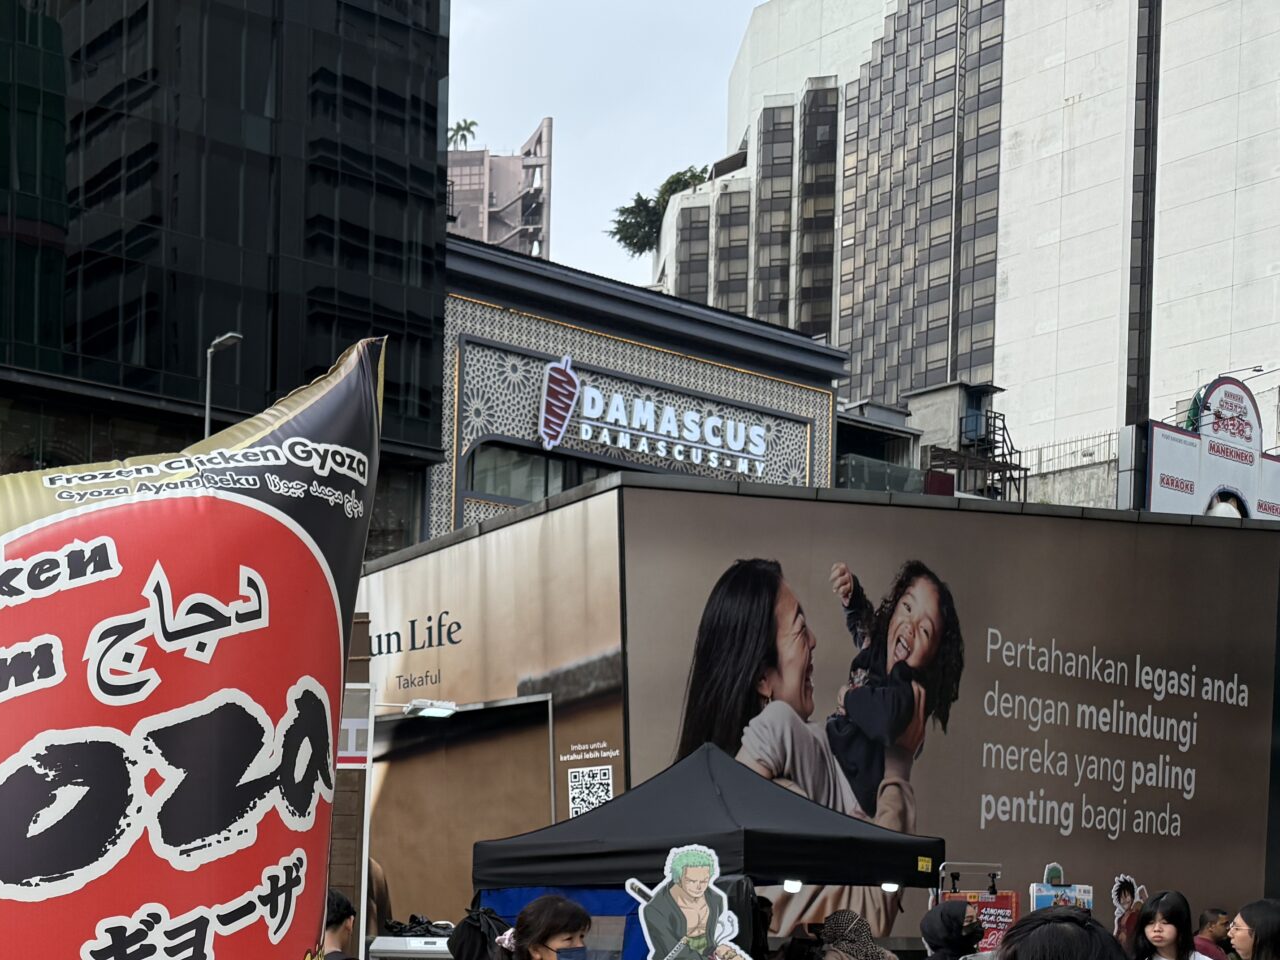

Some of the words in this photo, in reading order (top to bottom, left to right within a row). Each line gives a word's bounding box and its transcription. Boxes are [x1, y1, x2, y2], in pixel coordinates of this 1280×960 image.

[581, 386, 767, 456] DAMASCUS
[47, 463, 155, 487] Frozen
[163, 447, 281, 474] Chicken
[286, 440, 367, 481] Gyoza
[1208, 440, 1254, 466] MANEKINEKO
[57, 485, 130, 503] Gyoza
[136, 477, 202, 495] Ayam
[203, 473, 260, 489] Beku
[1160, 473, 1195, 495] KARAOKE
[1257, 499, 1280, 516] MANEK
[95, 572, 264, 697] دجاج
[369, 630, 403, 657] un
[408, 610, 463, 652] Life
[395, 668, 441, 690] Takaful
[986, 627, 1128, 687] Pertahankan
[1135, 653, 1197, 702] legasi
[1201, 672, 1250, 708] anda
[983, 679, 1070, 732] dengan
[1076, 698, 1198, 753] melindungi
[559, 753, 583, 762] ketahui
[583, 751, 600, 759] lebih
[600, 749, 620, 759] lanjut
[589, 740, 608, 750] untuk
[982, 738, 1068, 777] mereka
[1074, 753, 1126, 793] yang
[1131, 754, 1196, 800] paling
[980, 788, 1075, 837] penting
[1081, 793, 1127, 841] bagi
[1132, 802, 1182, 838] anda
